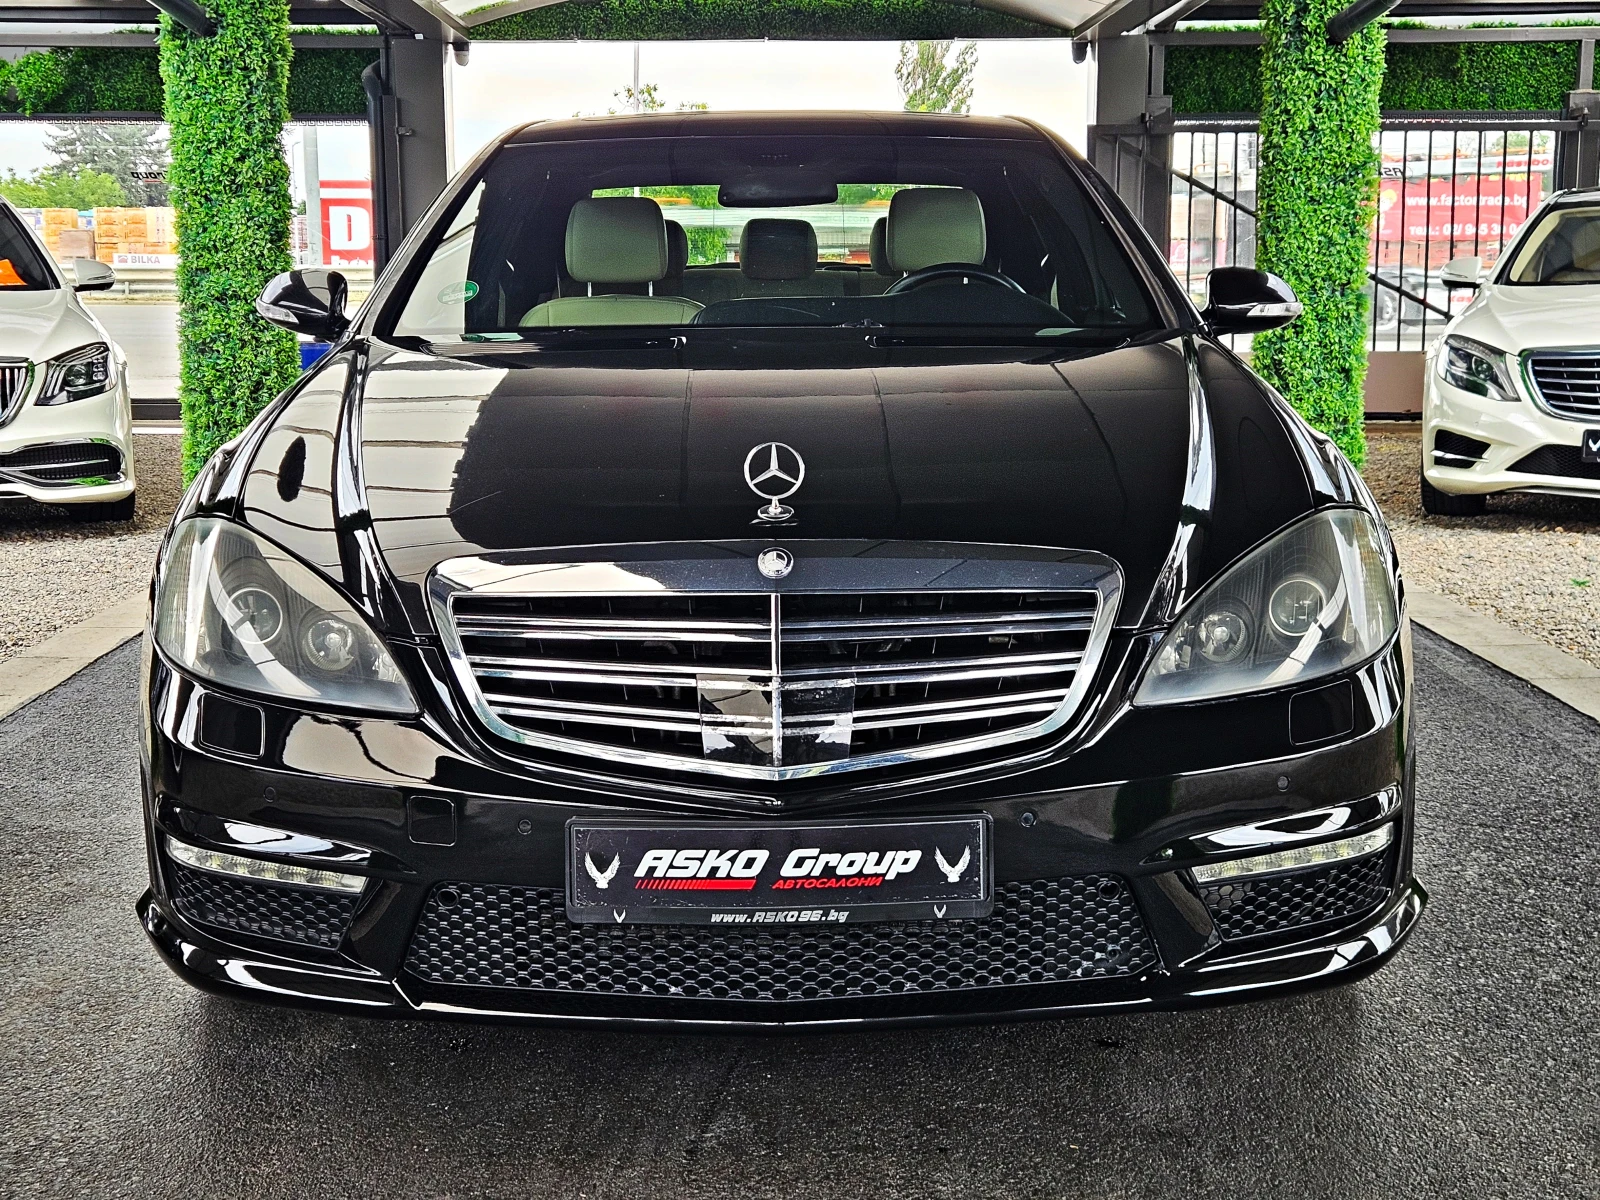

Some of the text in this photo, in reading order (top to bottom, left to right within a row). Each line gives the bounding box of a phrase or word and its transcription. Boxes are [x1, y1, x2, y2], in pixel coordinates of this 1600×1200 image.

[130, 255, 161, 264] BILKA
[633, 848, 922, 880] ASKO Group
[771, 876, 884, 890] АВТОСАЛОНИ
[710, 909, 850, 923] www.ASKO96.bg
